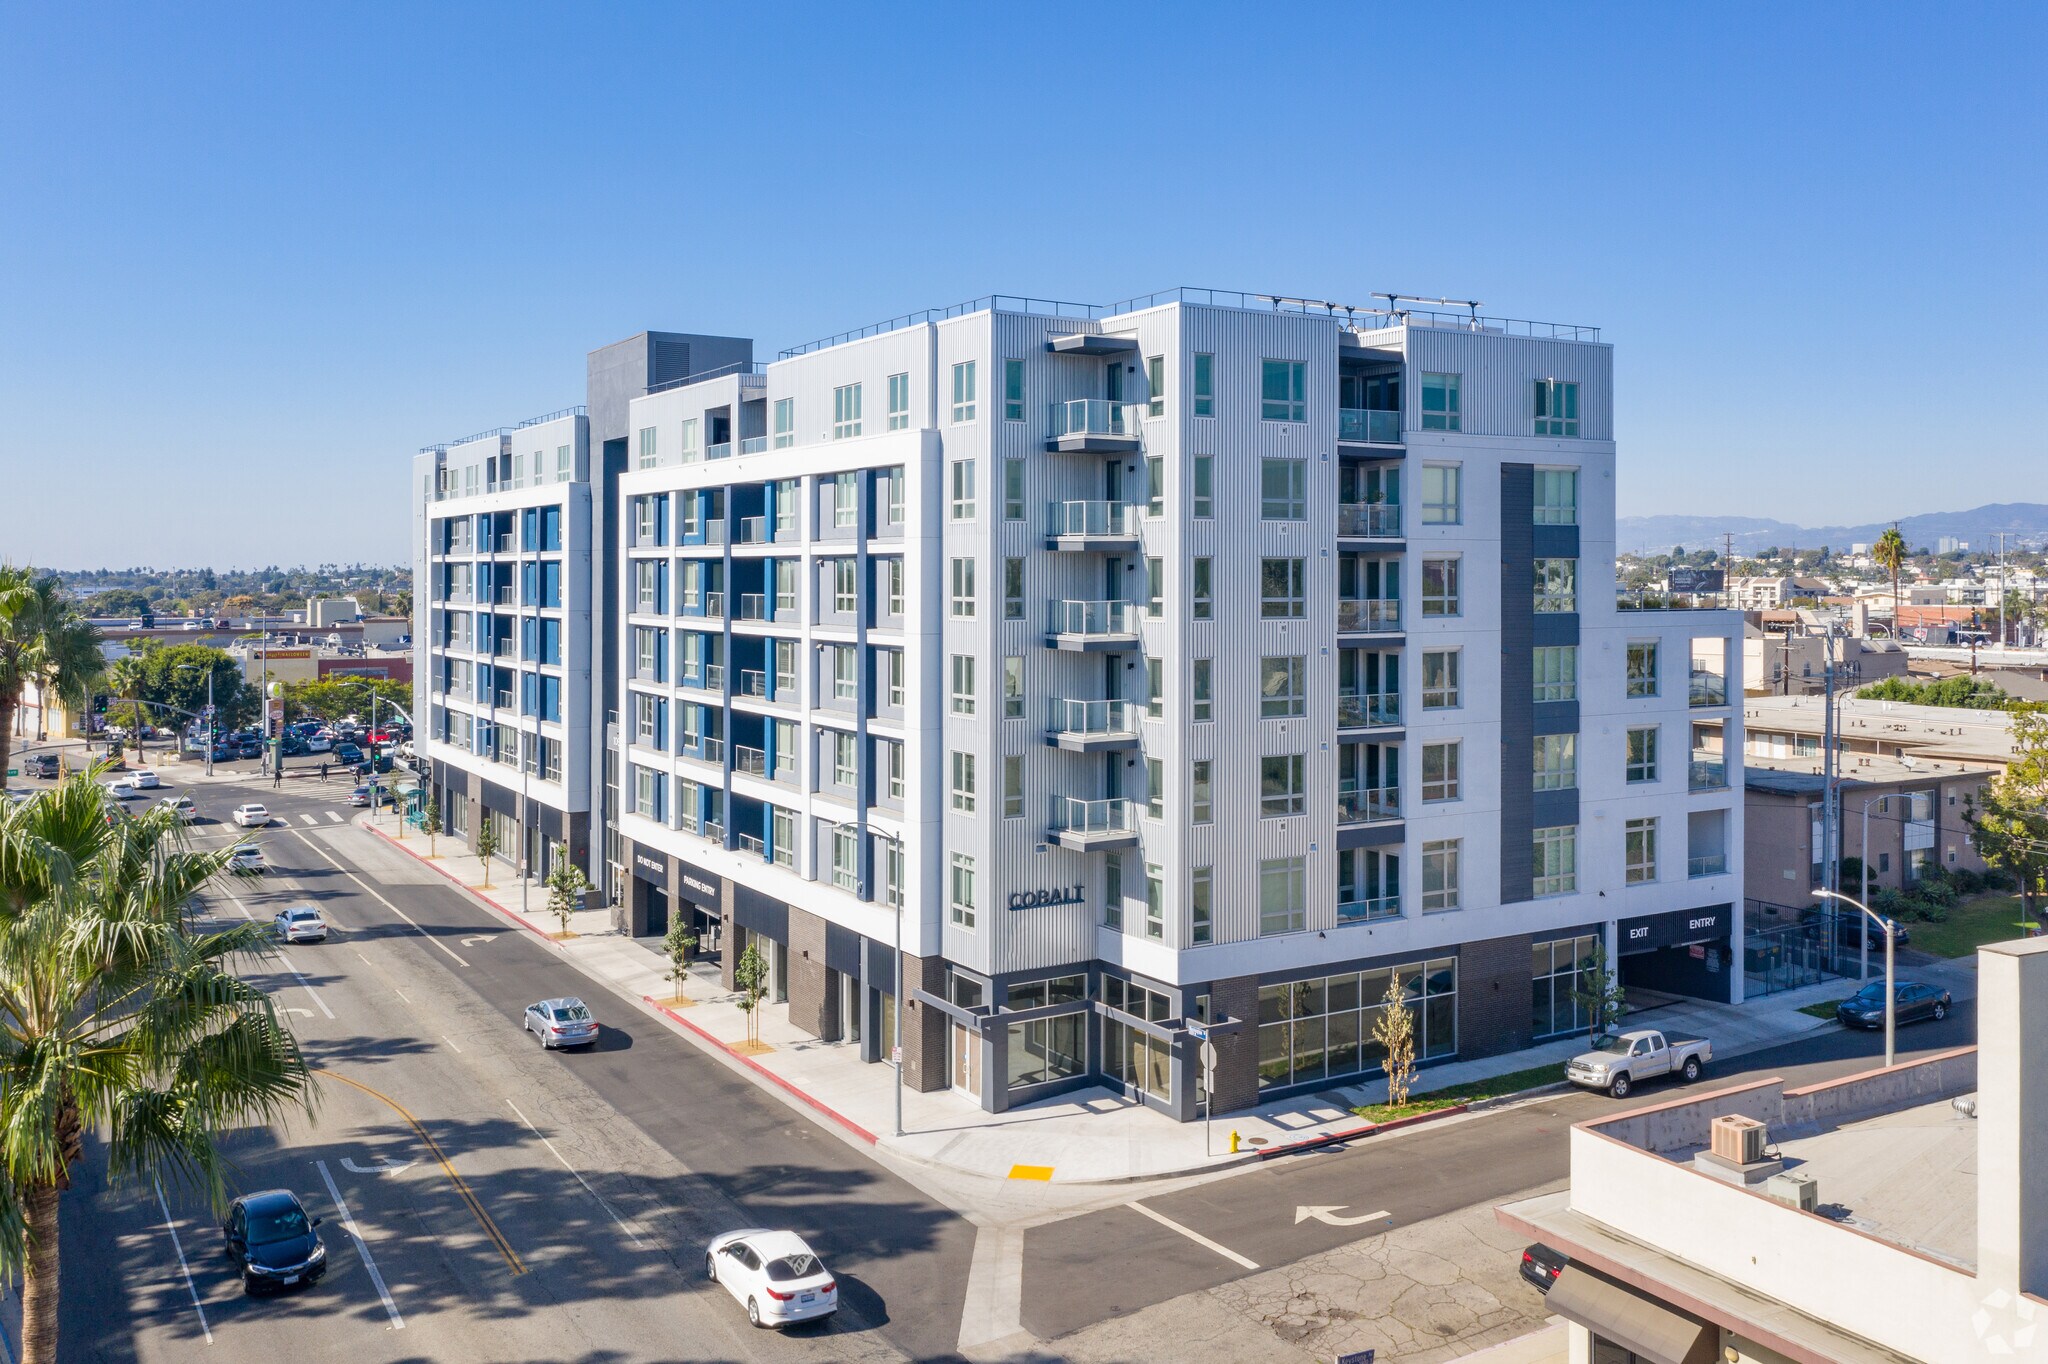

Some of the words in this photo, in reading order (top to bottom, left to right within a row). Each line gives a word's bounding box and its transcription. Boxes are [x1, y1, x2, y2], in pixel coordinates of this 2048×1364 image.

[637, 854, 643, 864] DO
[643, 857, 651, 867] NOT
[651, 860, 664, 873] ENTER
[684, 875, 701, 891] PARKING
[701, 883, 715, 897] ENTRY
[1010, 885, 1085, 908] COBALT
[1630, 926, 1649, 939] EXIT
[1689, 916, 1716, 929] ENTRY
